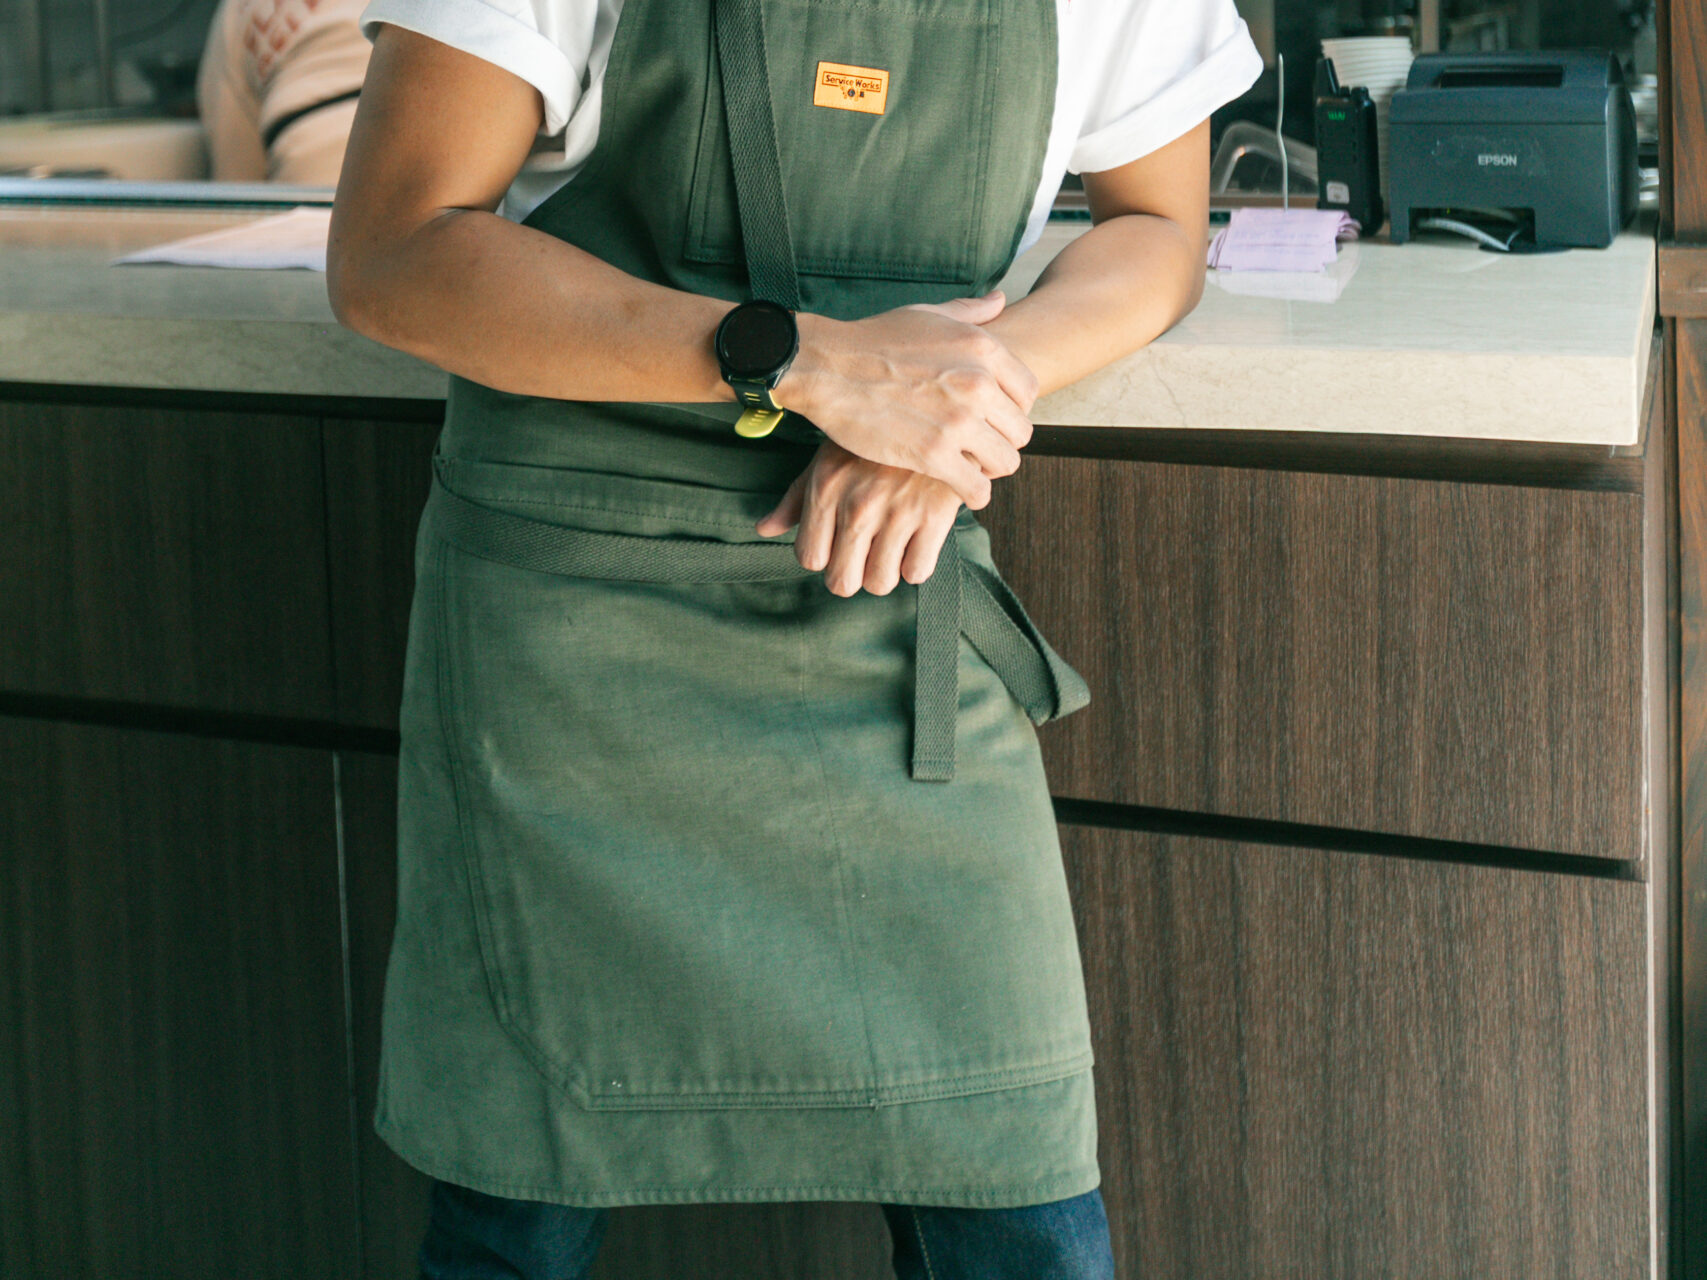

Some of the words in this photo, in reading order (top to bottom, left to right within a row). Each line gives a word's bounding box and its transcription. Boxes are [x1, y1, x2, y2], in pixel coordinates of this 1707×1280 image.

[826, 75, 854, 86] Service
[855, 79, 880, 90] Works
[1478, 154, 1517, 166] EPSON
